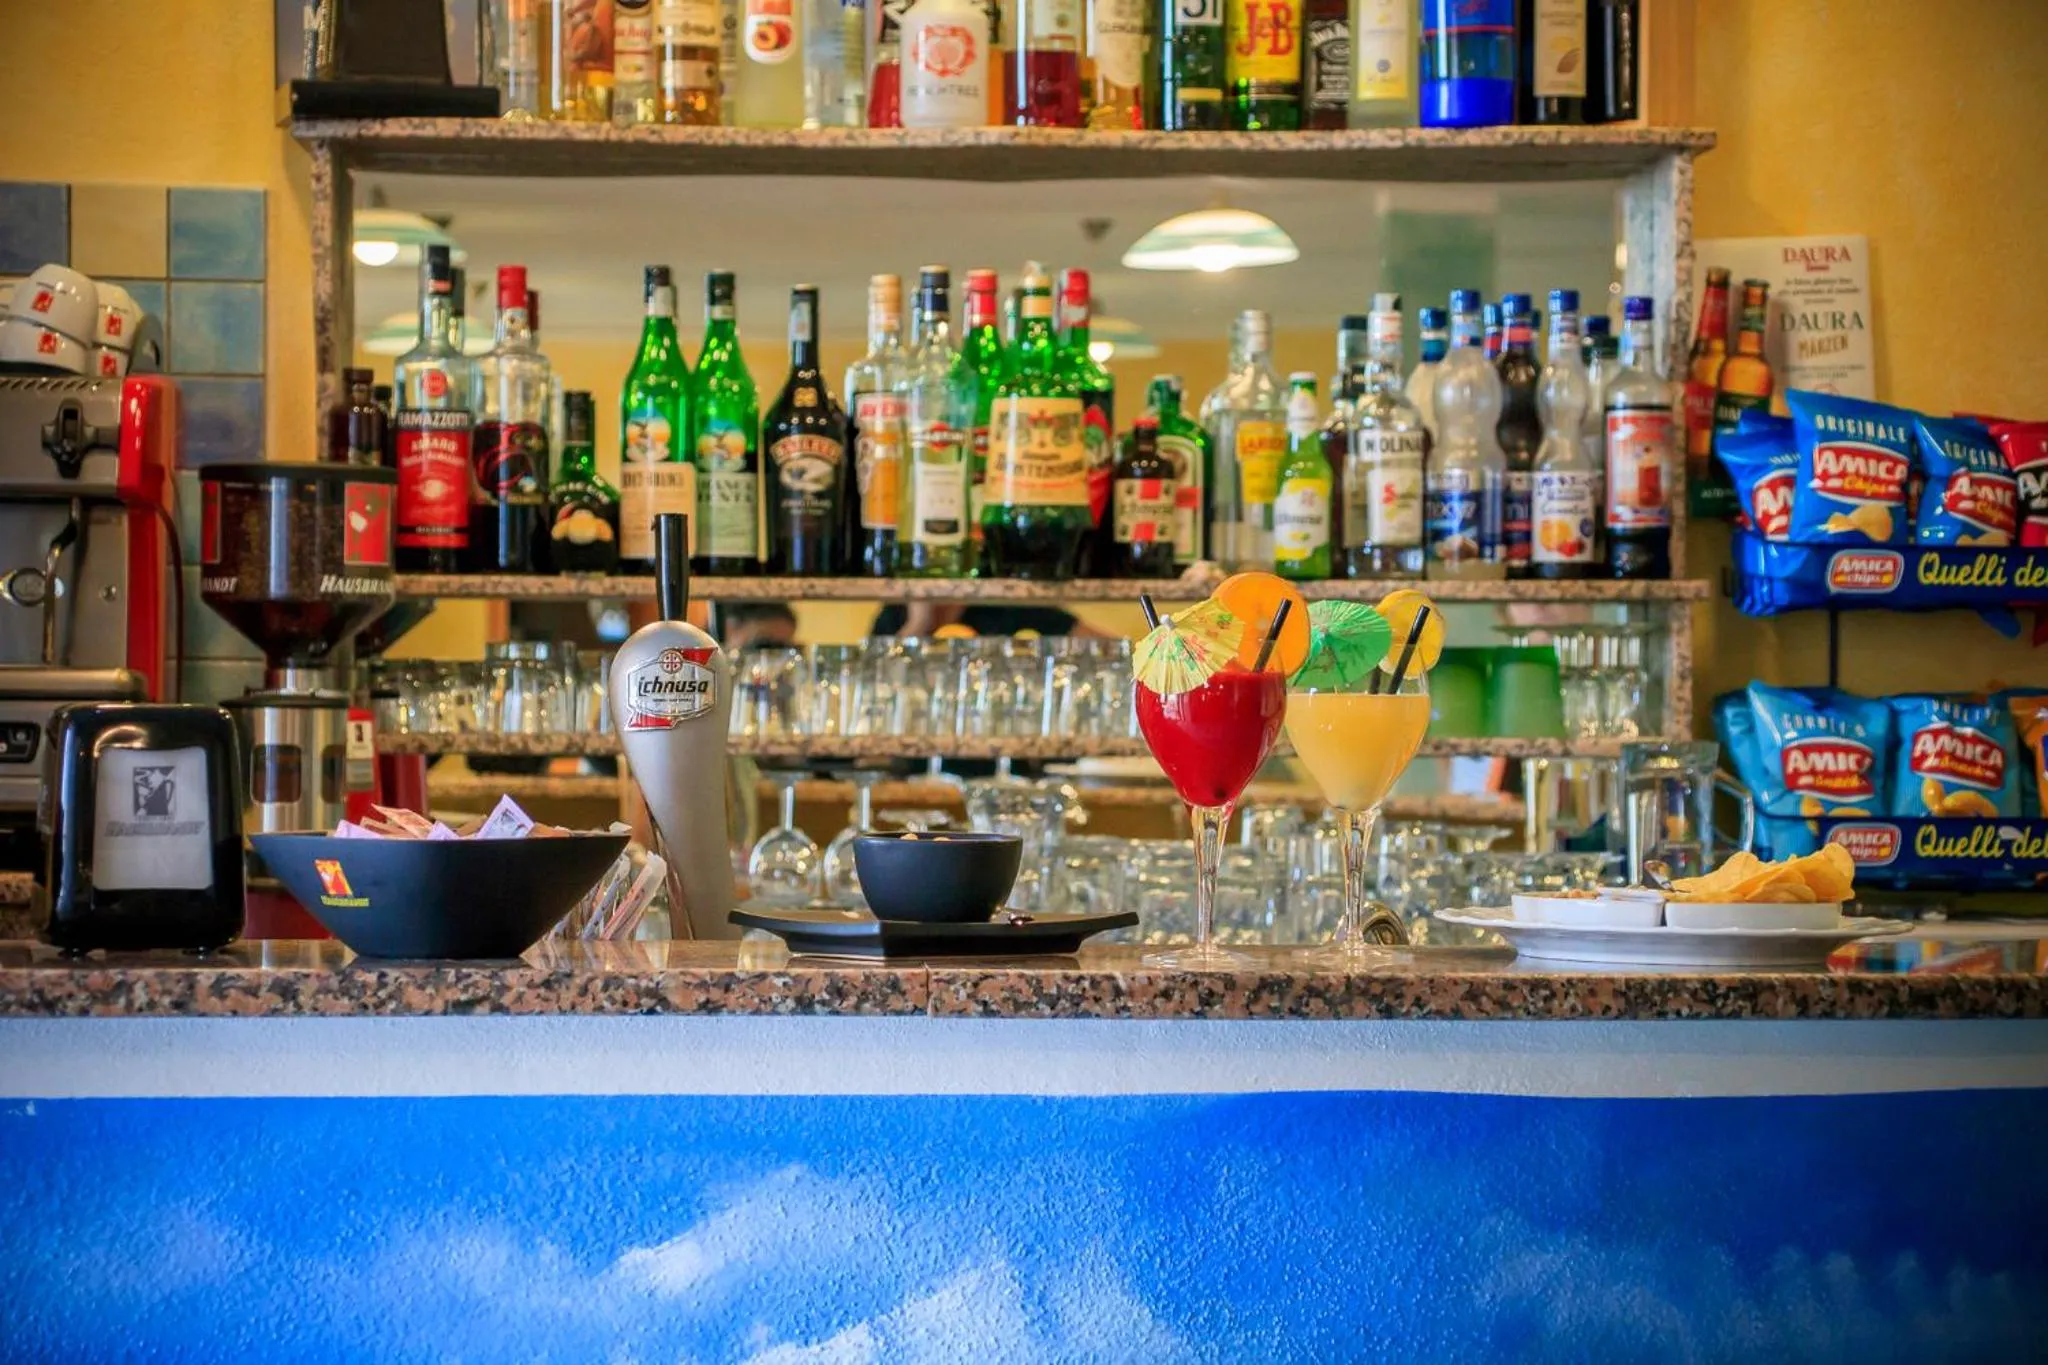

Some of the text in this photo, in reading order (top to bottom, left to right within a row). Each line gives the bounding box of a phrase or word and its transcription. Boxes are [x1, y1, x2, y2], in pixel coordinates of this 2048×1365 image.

[1783, 246, 1852, 263] DAURA
[1780, 310, 1865, 332] DAURA
[1815, 414, 1908, 443] ORIGINALE
[1815, 450, 1909, 480] AMICA
[1838, 558, 1894, 572] AMICA
[1917, 552, 2007, 587] Quelli
[638, 676, 709, 697] ichnusa
[1914, 732, 2004, 768] AMICA
[1914, 823, 2004, 858] Quelli
